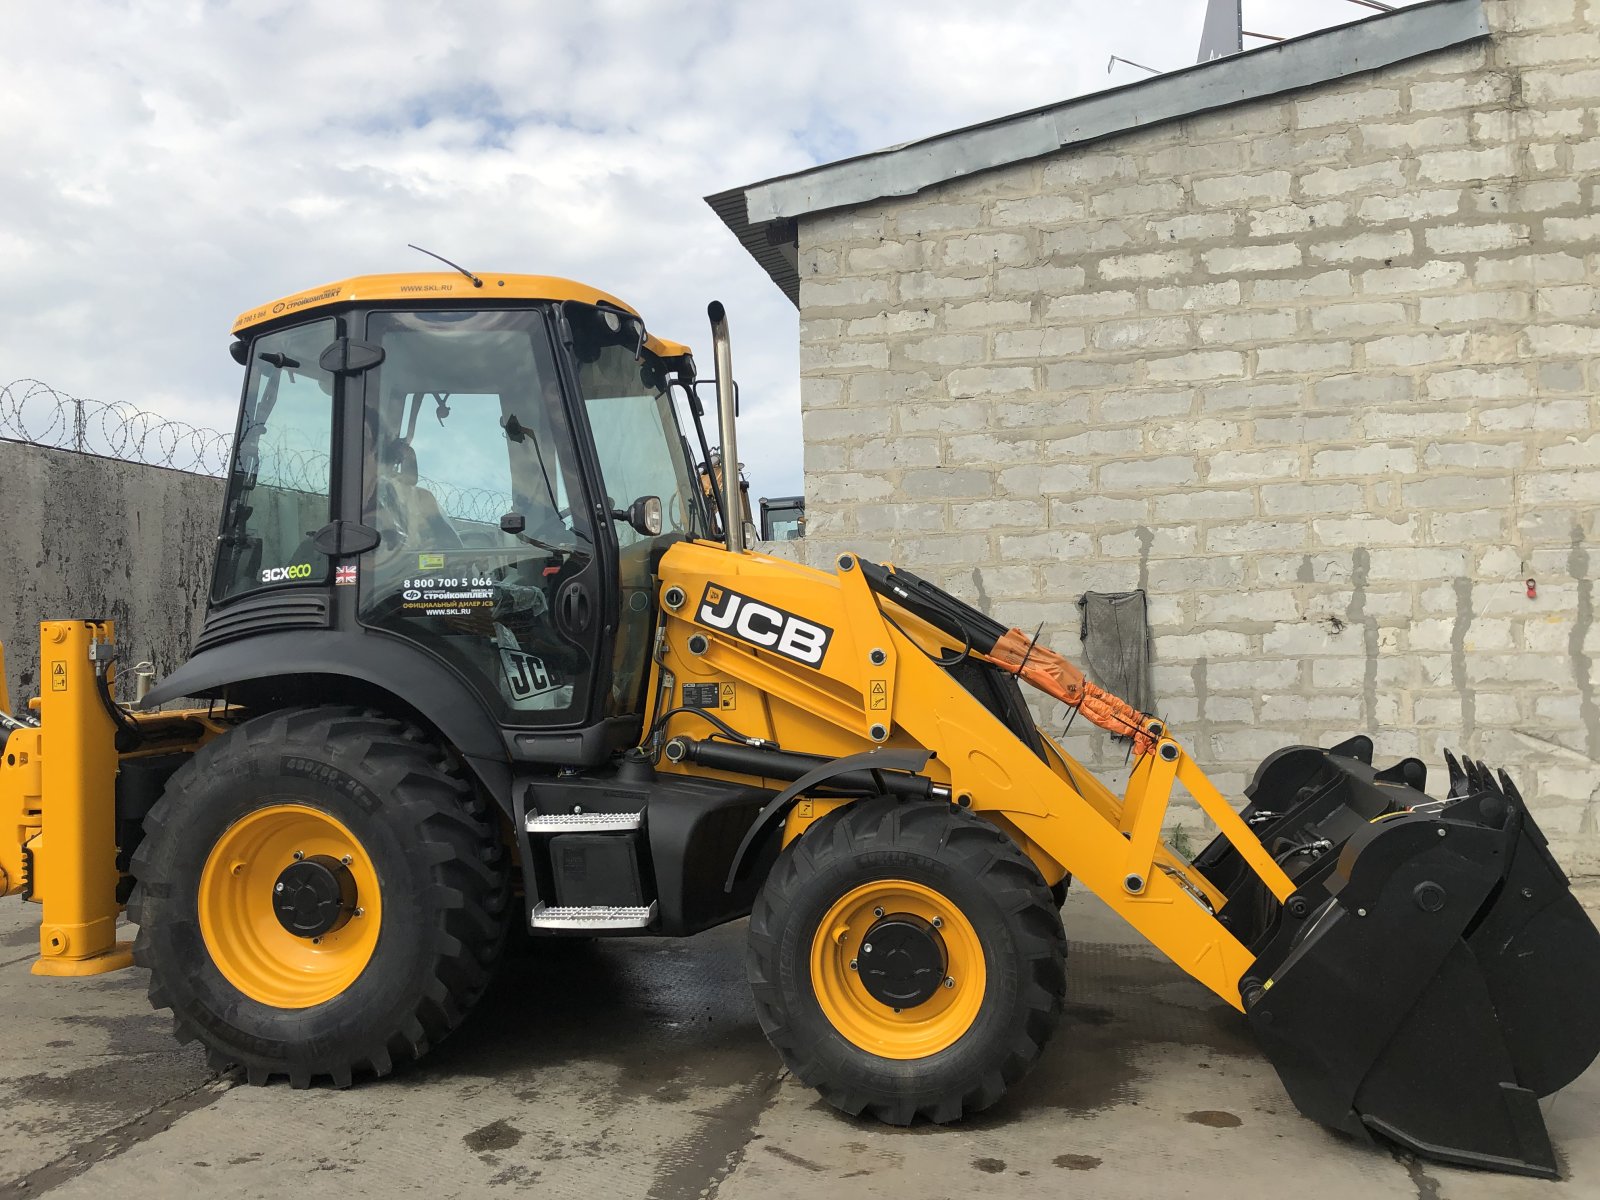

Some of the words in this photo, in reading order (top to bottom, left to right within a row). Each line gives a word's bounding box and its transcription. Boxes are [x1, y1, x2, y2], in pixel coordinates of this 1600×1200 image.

[400, 284, 453, 292] WWW.SKL.RU
[403, 579, 411, 588] 8
[414, 579, 434, 588] 800
[437, 578, 458, 587] 700
[461, 578, 468, 587] 5
[471, 577, 492, 587] 066
[423, 592, 494, 600] СТРОЙКОМПЛЕКТ
[402, 600, 457, 609] ОФИЦИАЛЬНЫЙ
[458, 600, 481, 608] ДИЛЕР
[426, 608, 471, 616] WWW.SKL.RU
[700, 594, 827, 664] JCB
[510, 653, 550, 695] JC
